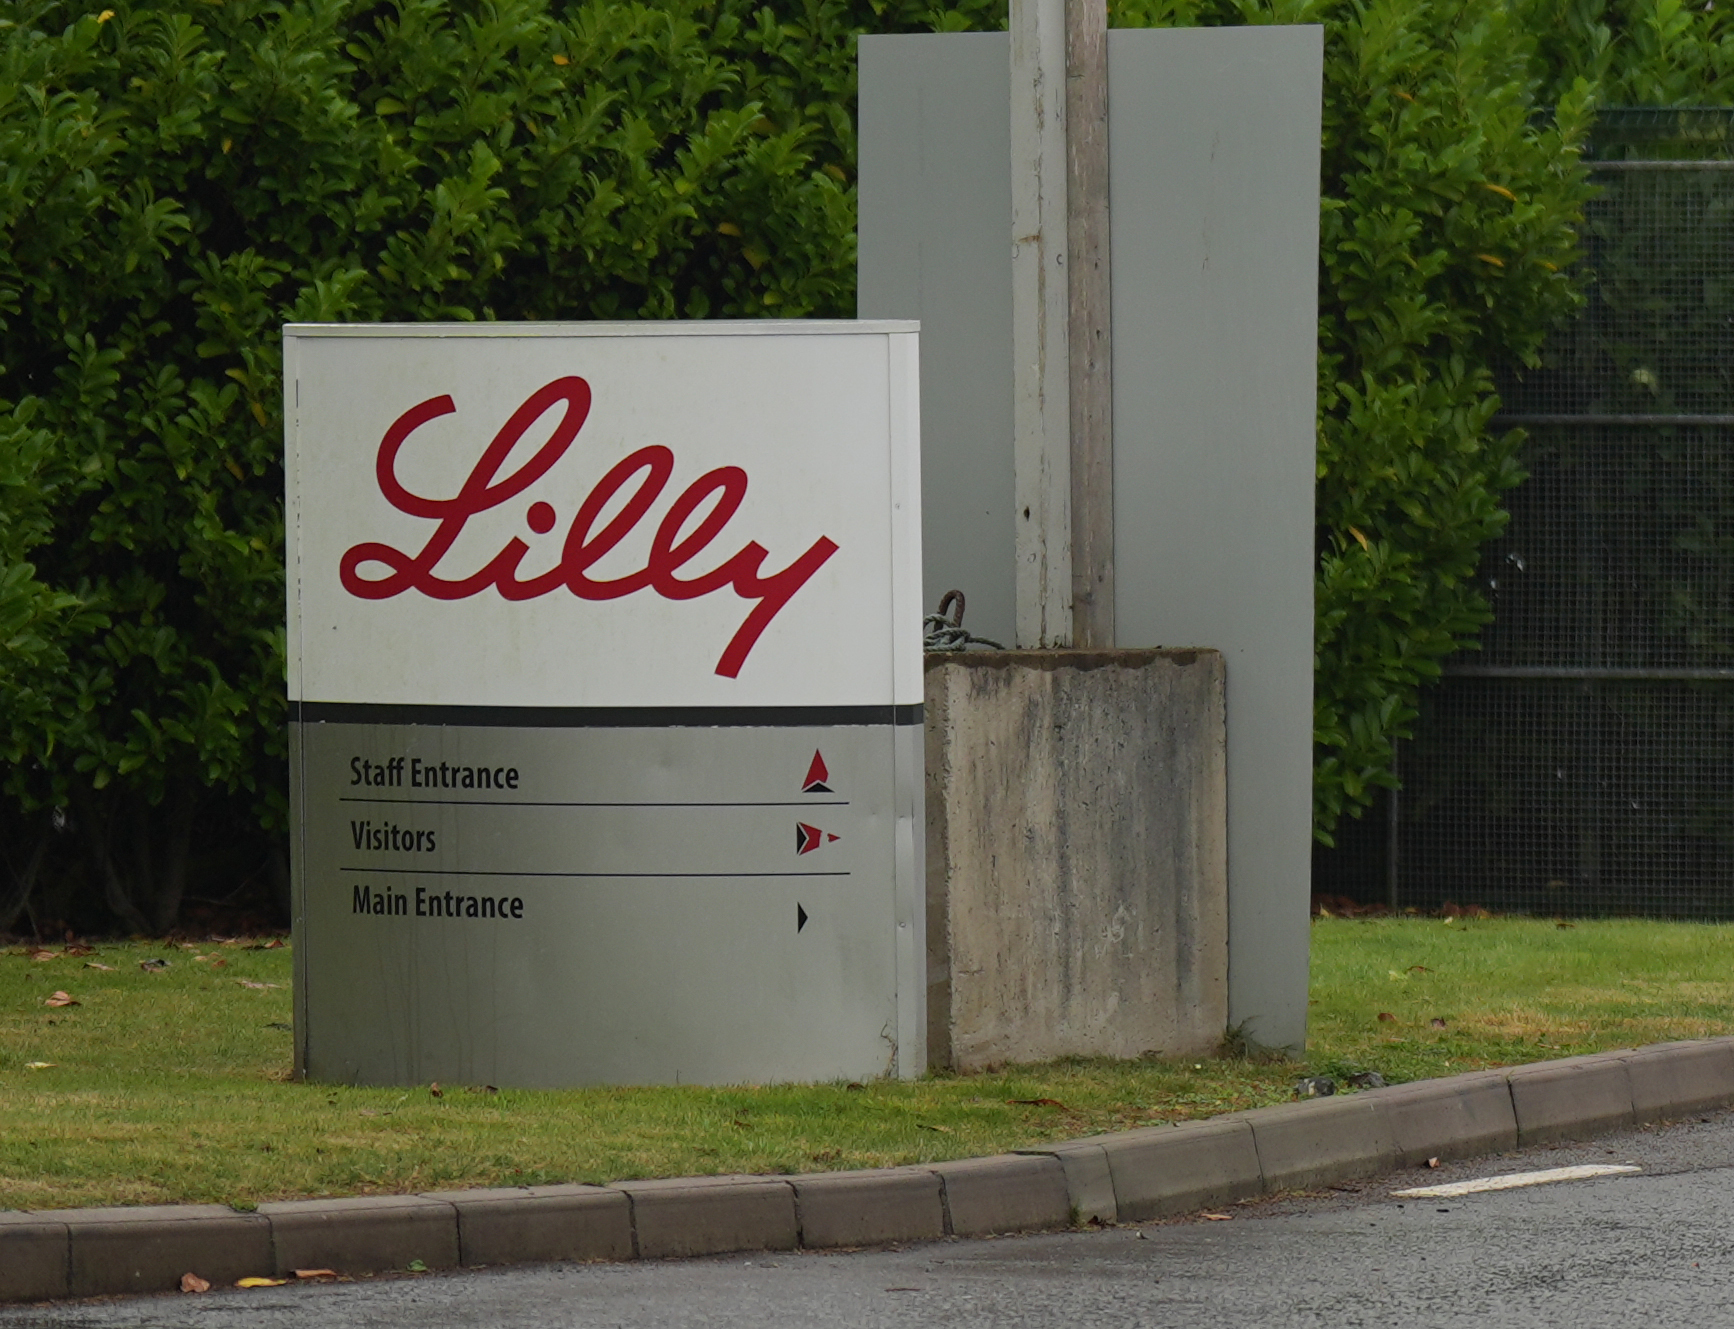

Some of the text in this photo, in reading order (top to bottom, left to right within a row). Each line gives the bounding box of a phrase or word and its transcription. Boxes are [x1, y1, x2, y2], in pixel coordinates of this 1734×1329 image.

[339, 375, 840, 679] Lilly
[350, 756, 519, 789] Staff Entrance
[350, 820, 436, 852] Visitors
[352, 884, 524, 919] Main Entrance
